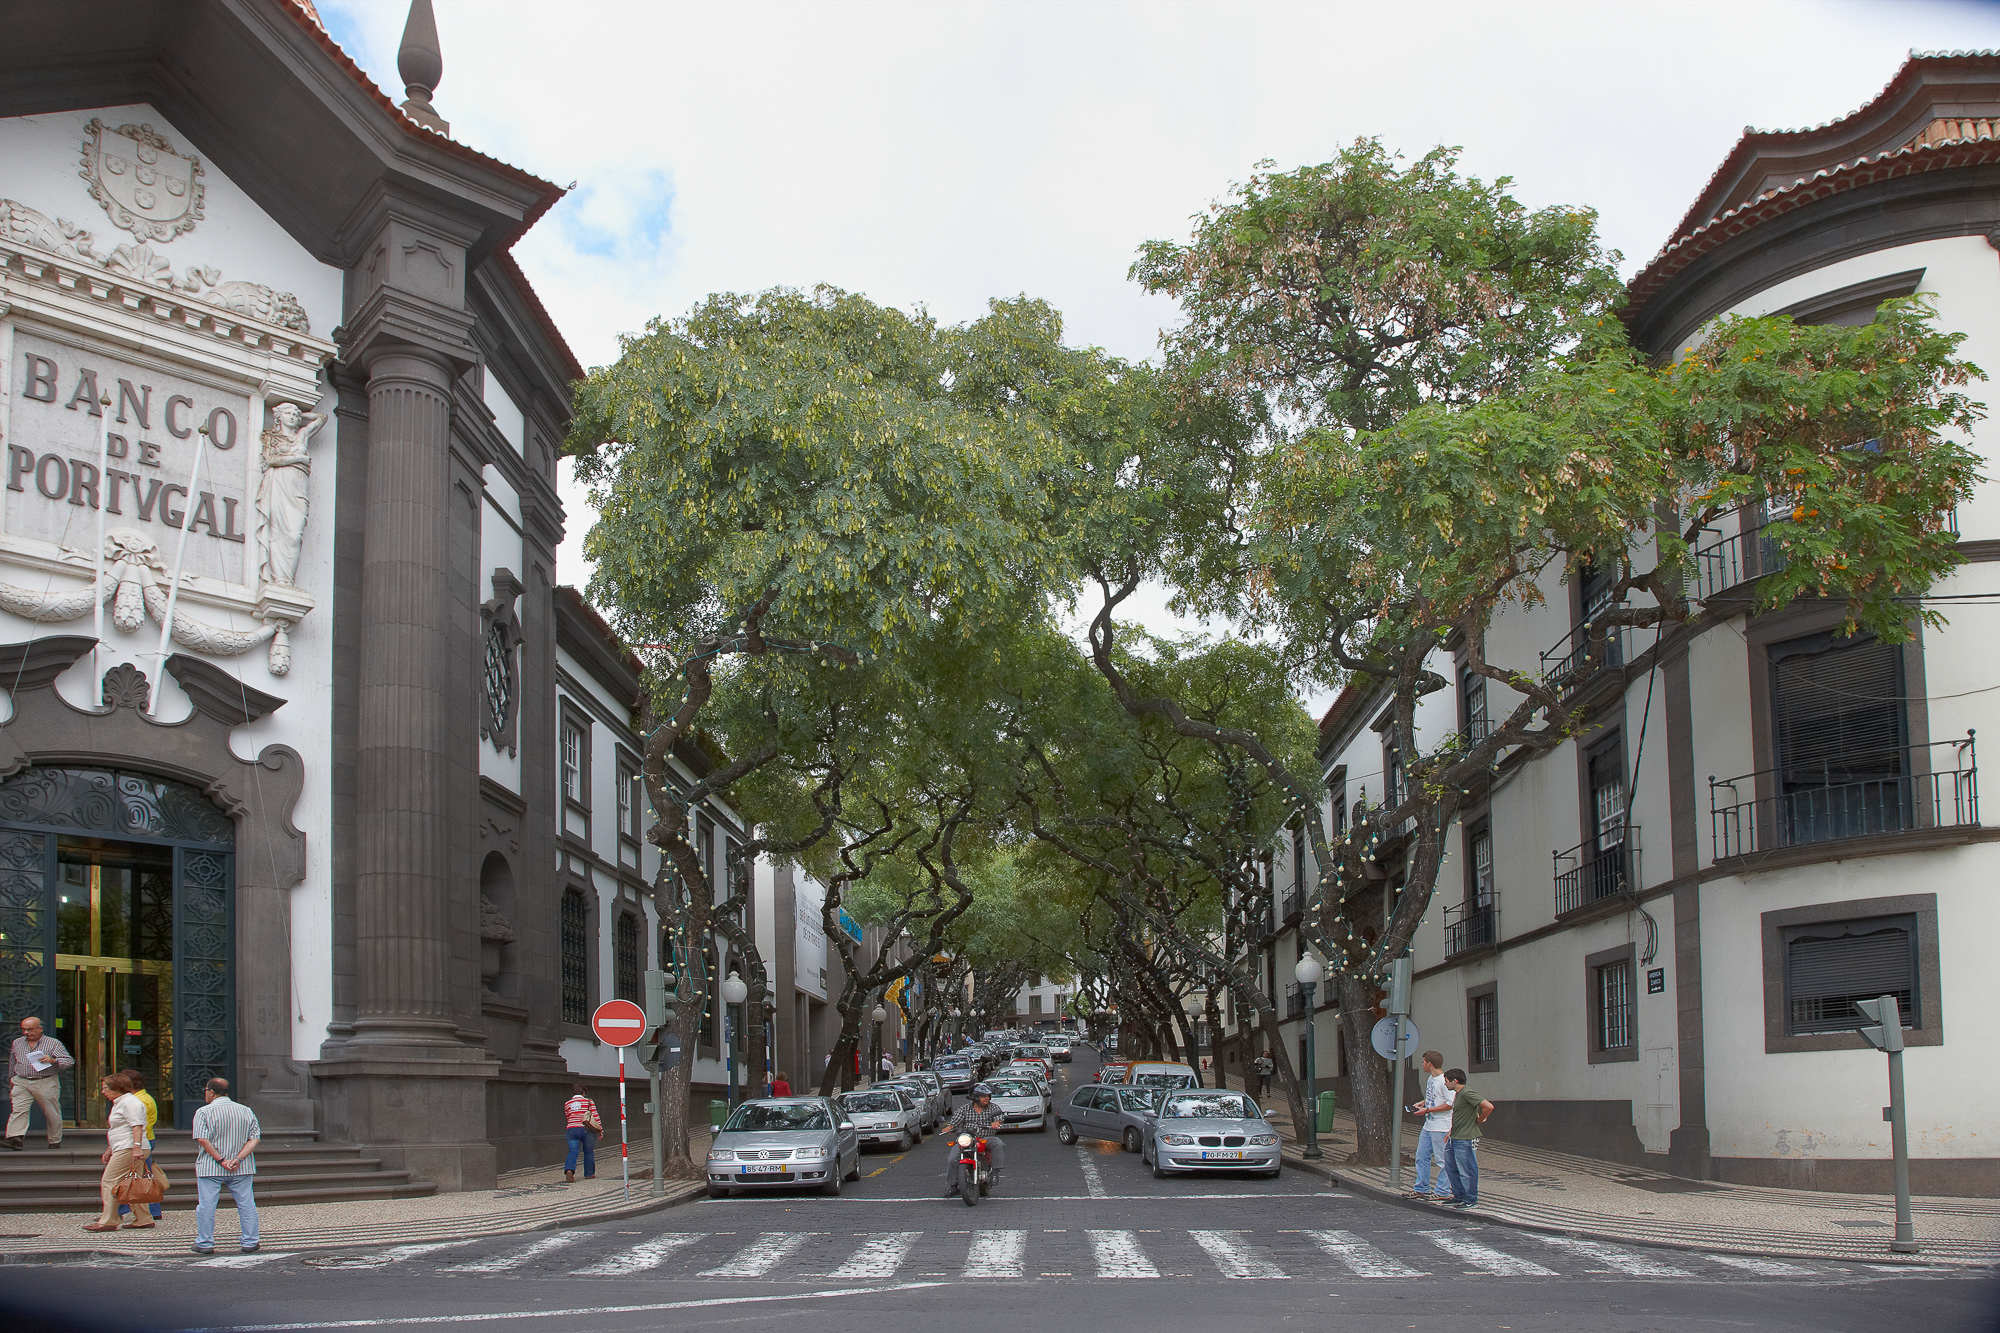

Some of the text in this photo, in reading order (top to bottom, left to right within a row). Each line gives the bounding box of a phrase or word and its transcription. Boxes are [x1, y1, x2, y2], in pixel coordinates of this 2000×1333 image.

[23, 351, 238, 451] BANCO
[107, 432, 161, 468] DE
[7, 443, 246, 543] PORTVGAL
